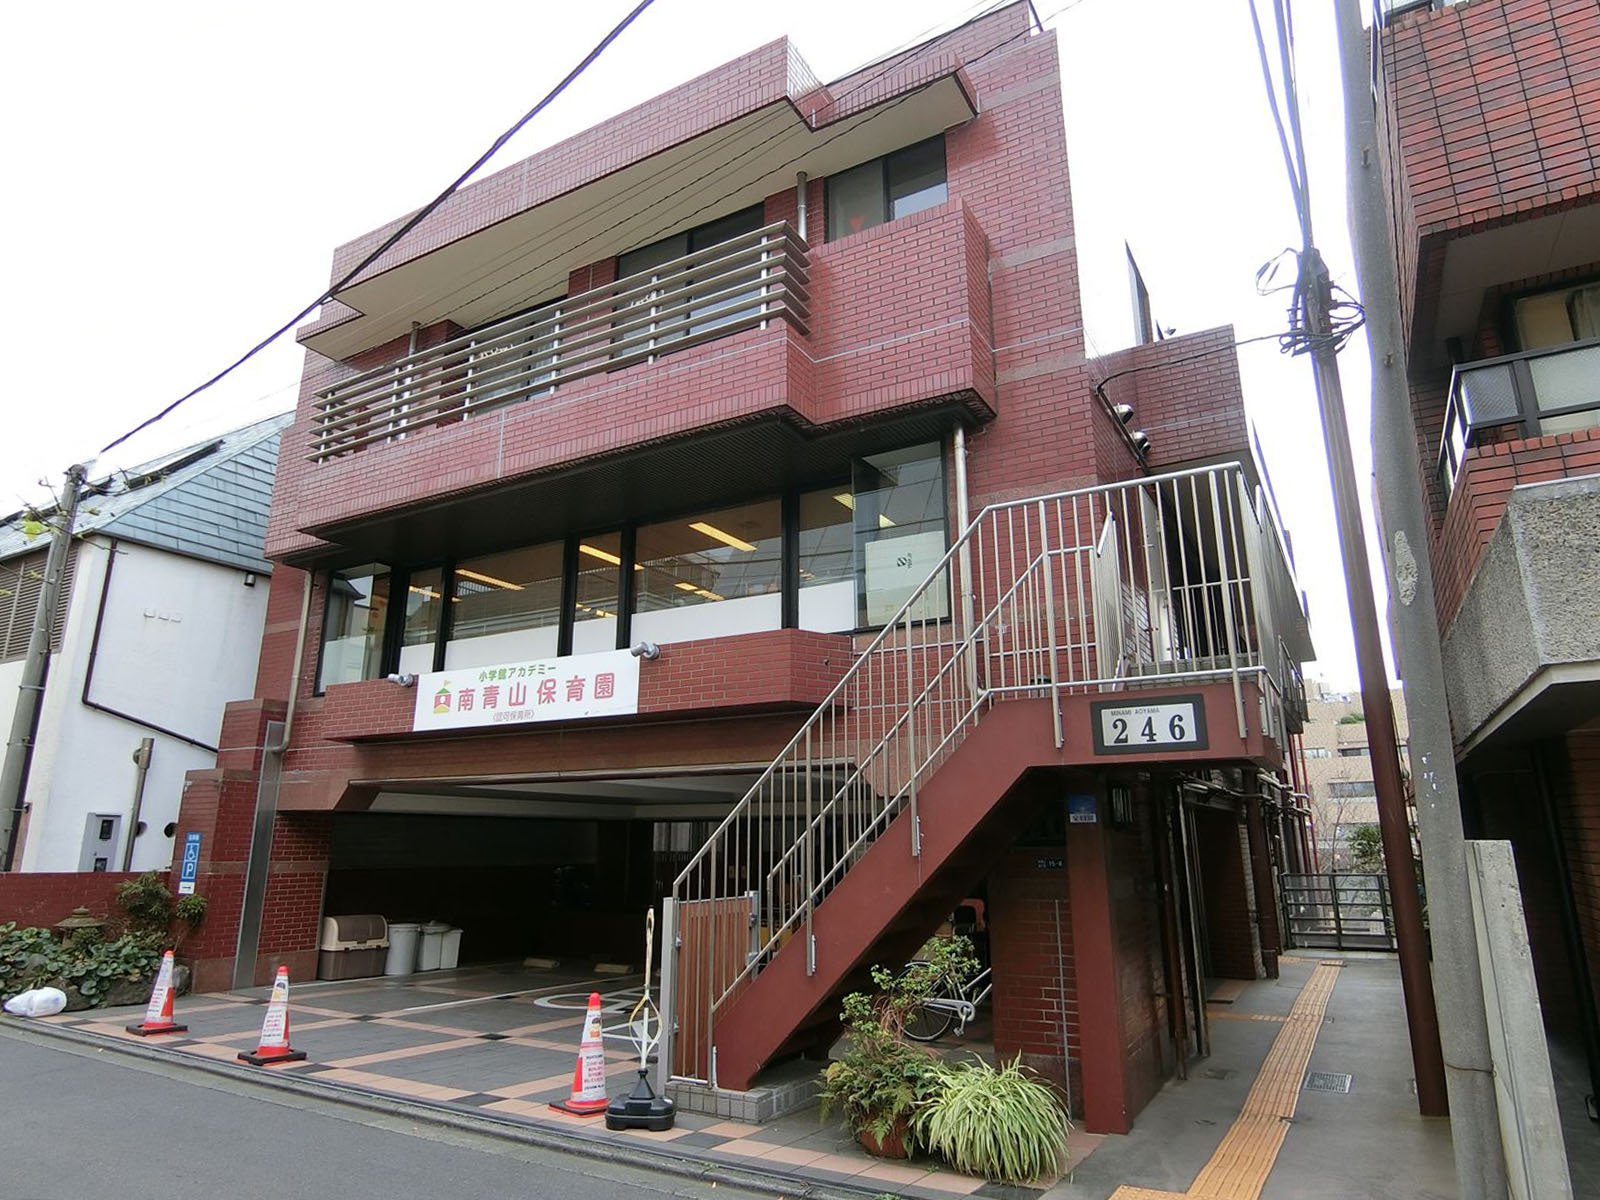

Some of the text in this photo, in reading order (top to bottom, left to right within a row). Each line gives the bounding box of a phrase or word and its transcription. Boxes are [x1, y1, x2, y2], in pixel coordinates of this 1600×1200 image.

[479, 665, 557, 682] 小学館アカデミー
[458, 673, 615, 711] 南青山保育園
[1113, 715, 1185, 744] 246
[187, 863, 194, 876] P
